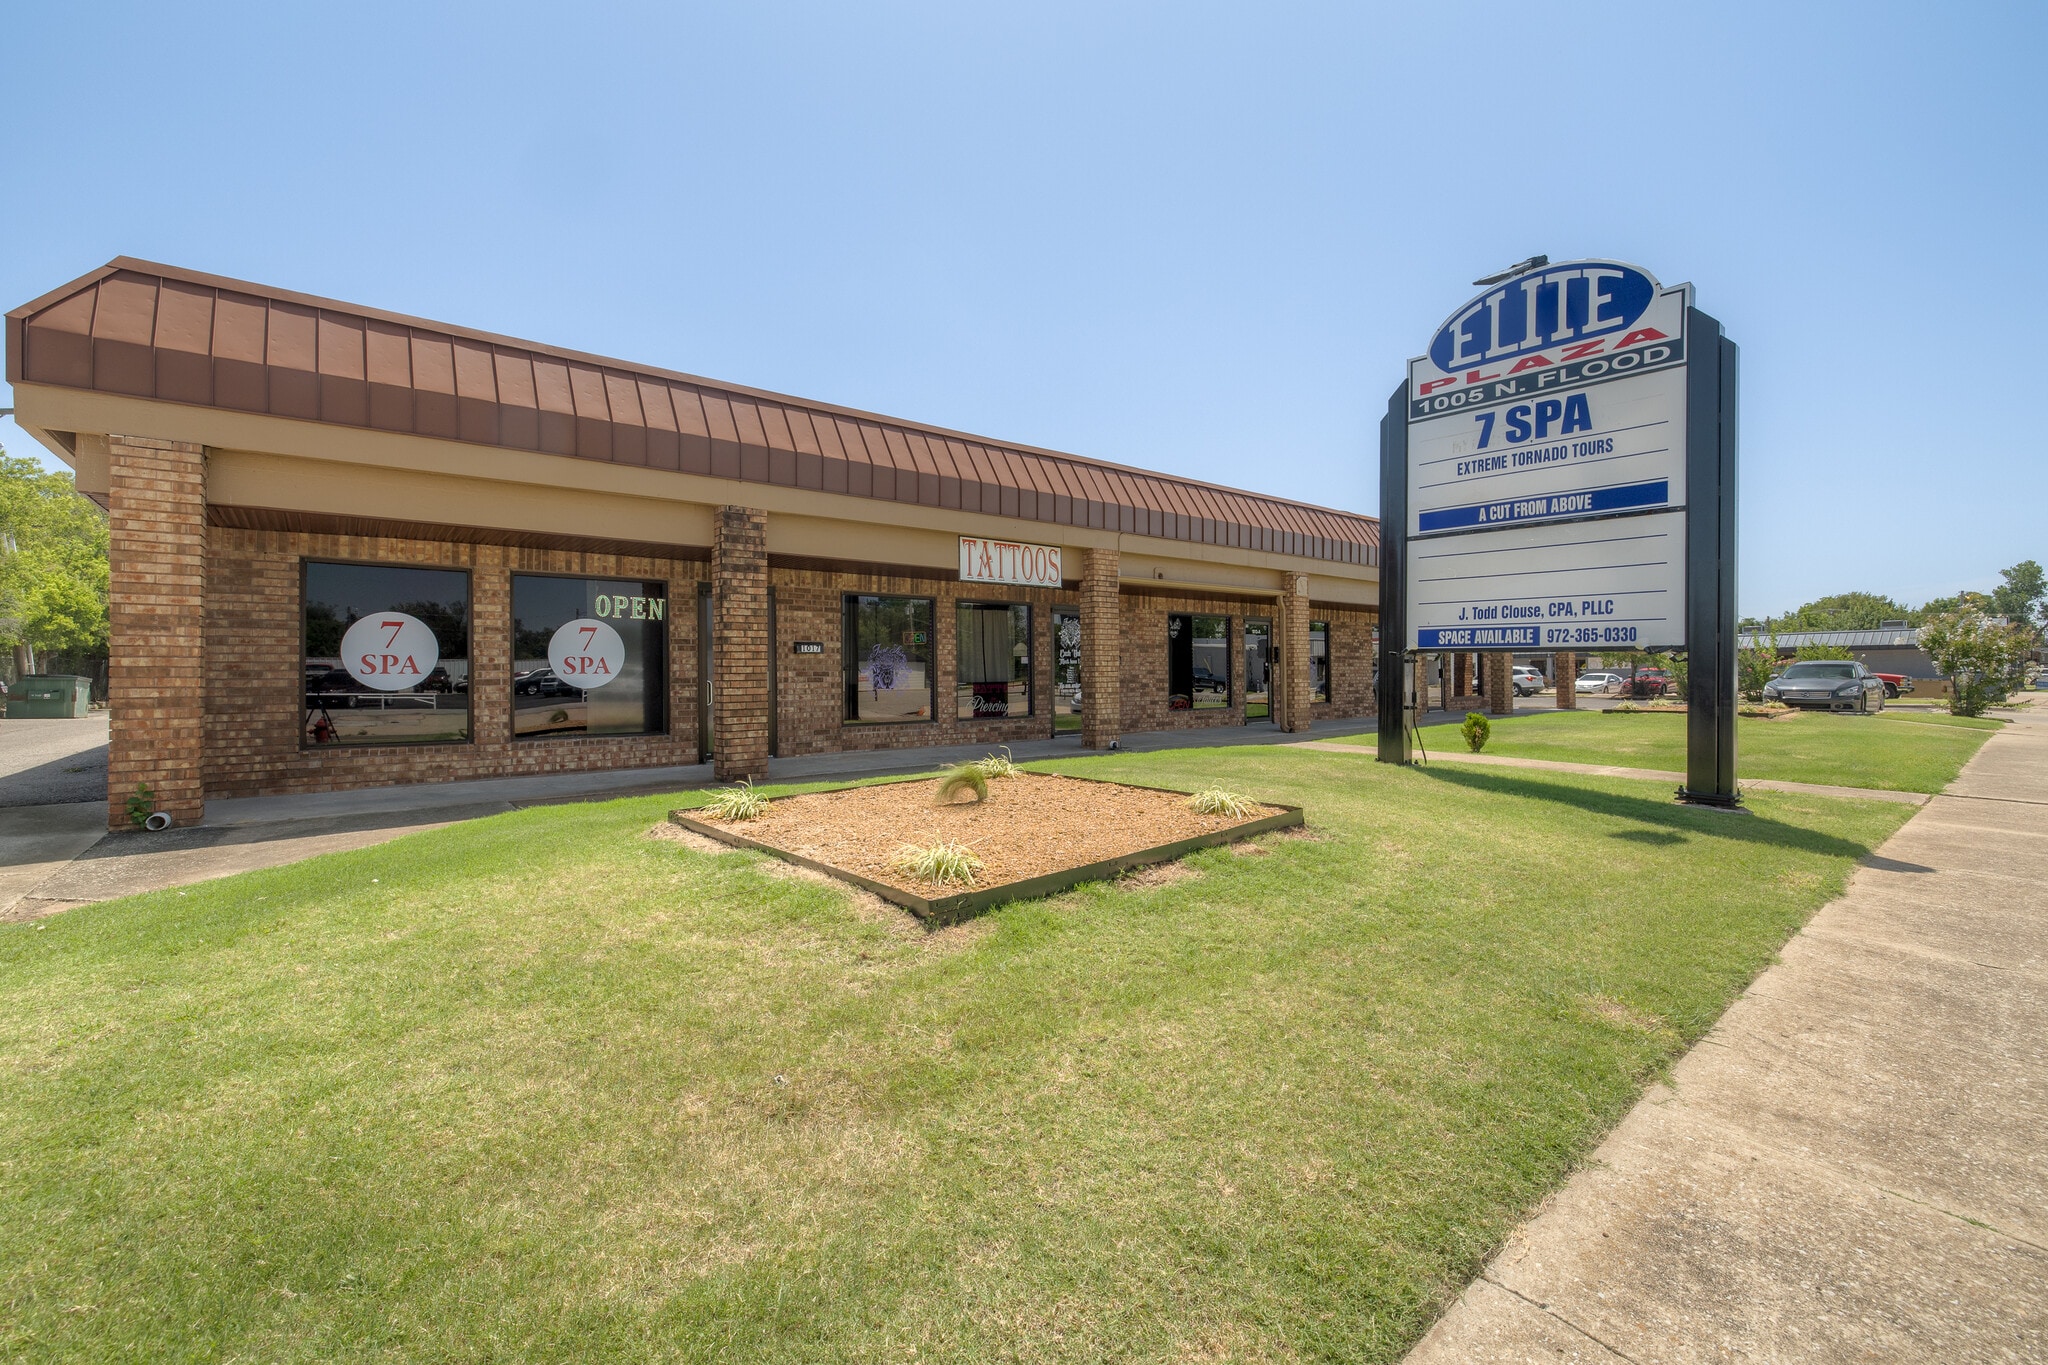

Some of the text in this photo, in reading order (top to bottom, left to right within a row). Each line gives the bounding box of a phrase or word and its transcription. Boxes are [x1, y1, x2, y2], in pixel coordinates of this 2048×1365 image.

[1449, 268, 1623, 368] ELITE
[1420, 327, 1669, 396] PLAZA
[1418, 345, 1671, 413] 1005 N. FLOOD
[1474, 392, 1593, 449] 7 SPA
[1457, 438, 1614, 476] EXTREME TORNADO TOURS
[1478, 494, 1592, 522] A CUT FROM ABOVE
[962, 538, 1060, 584] TATTOOS
[595, 594, 665, 621] OPEN
[1458, 599, 1614, 621] J. Todd Clouse, CPA, PLLC
[379, 621, 404, 649] 7
[578, 626, 598, 652] 7
[1438, 626, 1637, 646] SPACE AVAILABLE 972-365-0330
[360, 653, 422, 676] SPA
[563, 656, 611, 676] SPA
[966, 695, 1009, 717] Piercing
